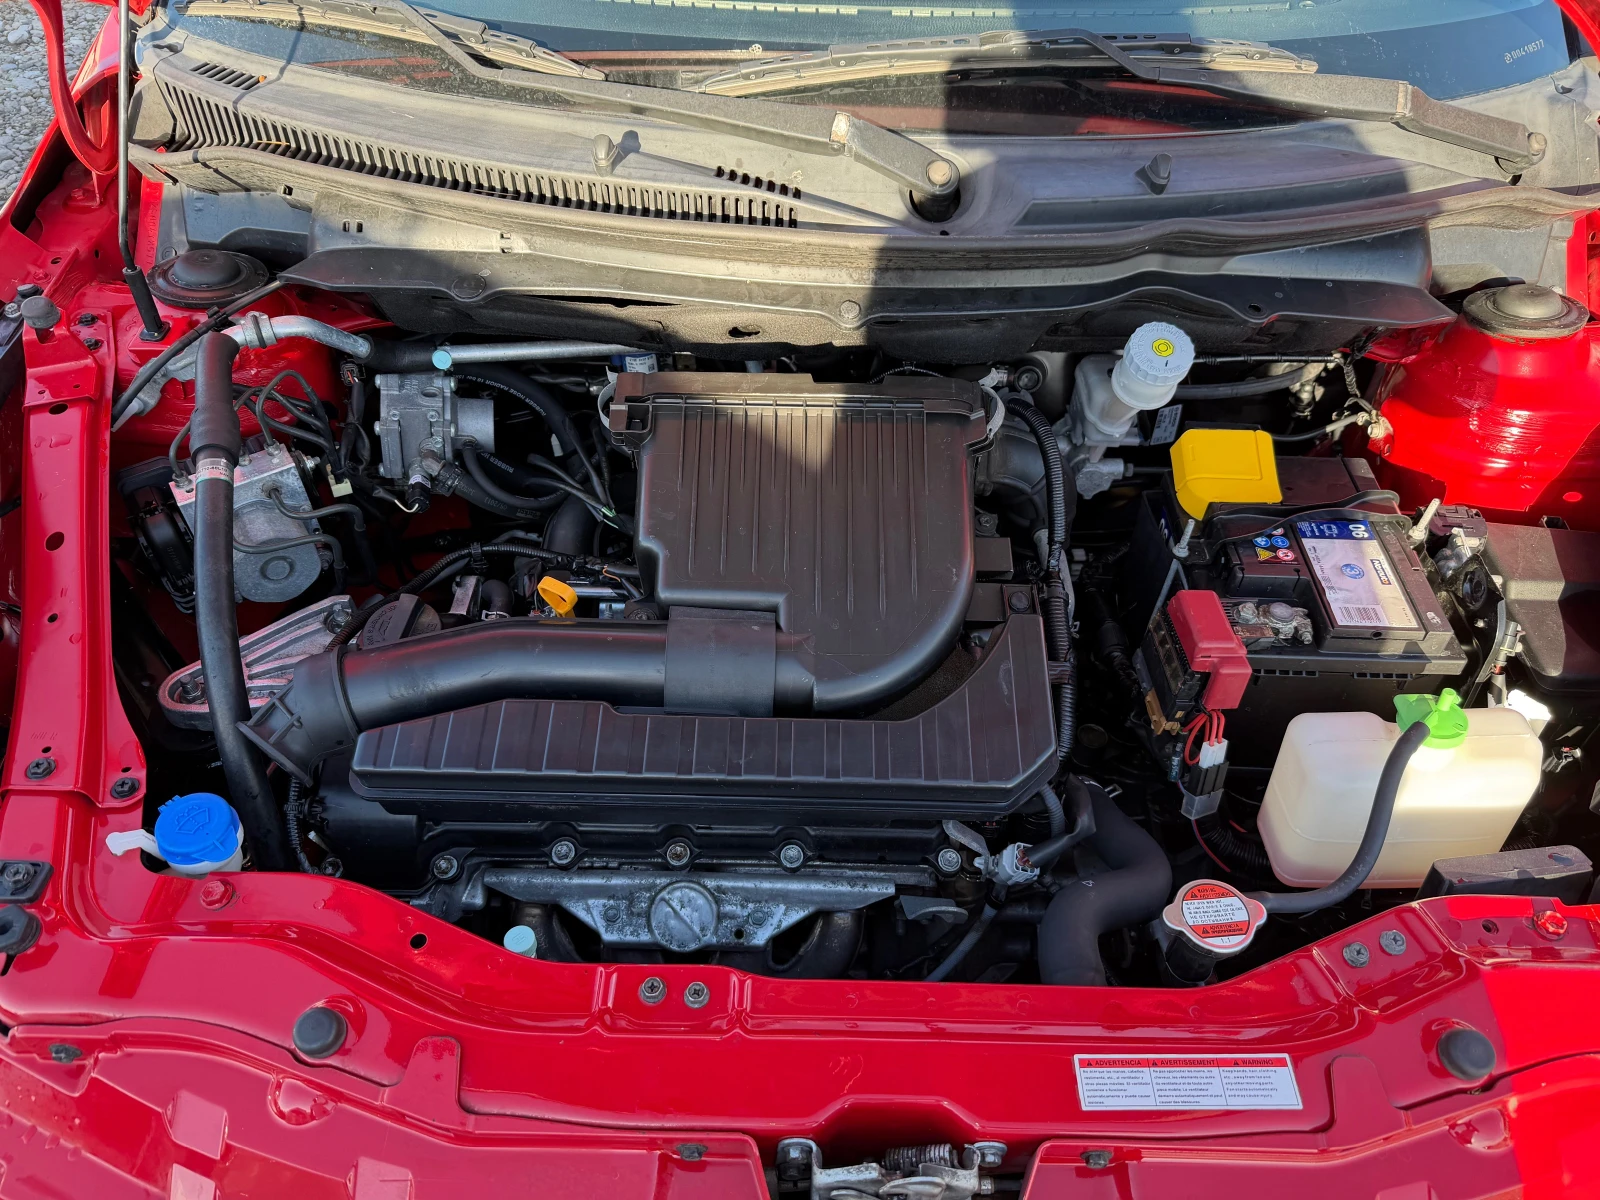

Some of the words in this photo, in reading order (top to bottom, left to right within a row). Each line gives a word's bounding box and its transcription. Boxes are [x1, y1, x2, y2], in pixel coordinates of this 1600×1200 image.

[1511, 39, 1544, 58] 00418577
[509, 388, 526, 400] HOSE
[525, 397, 546, 416] RUBBER
[490, 456, 514, 474] RUBBER
[1349, 524, 1368, 538] 06
